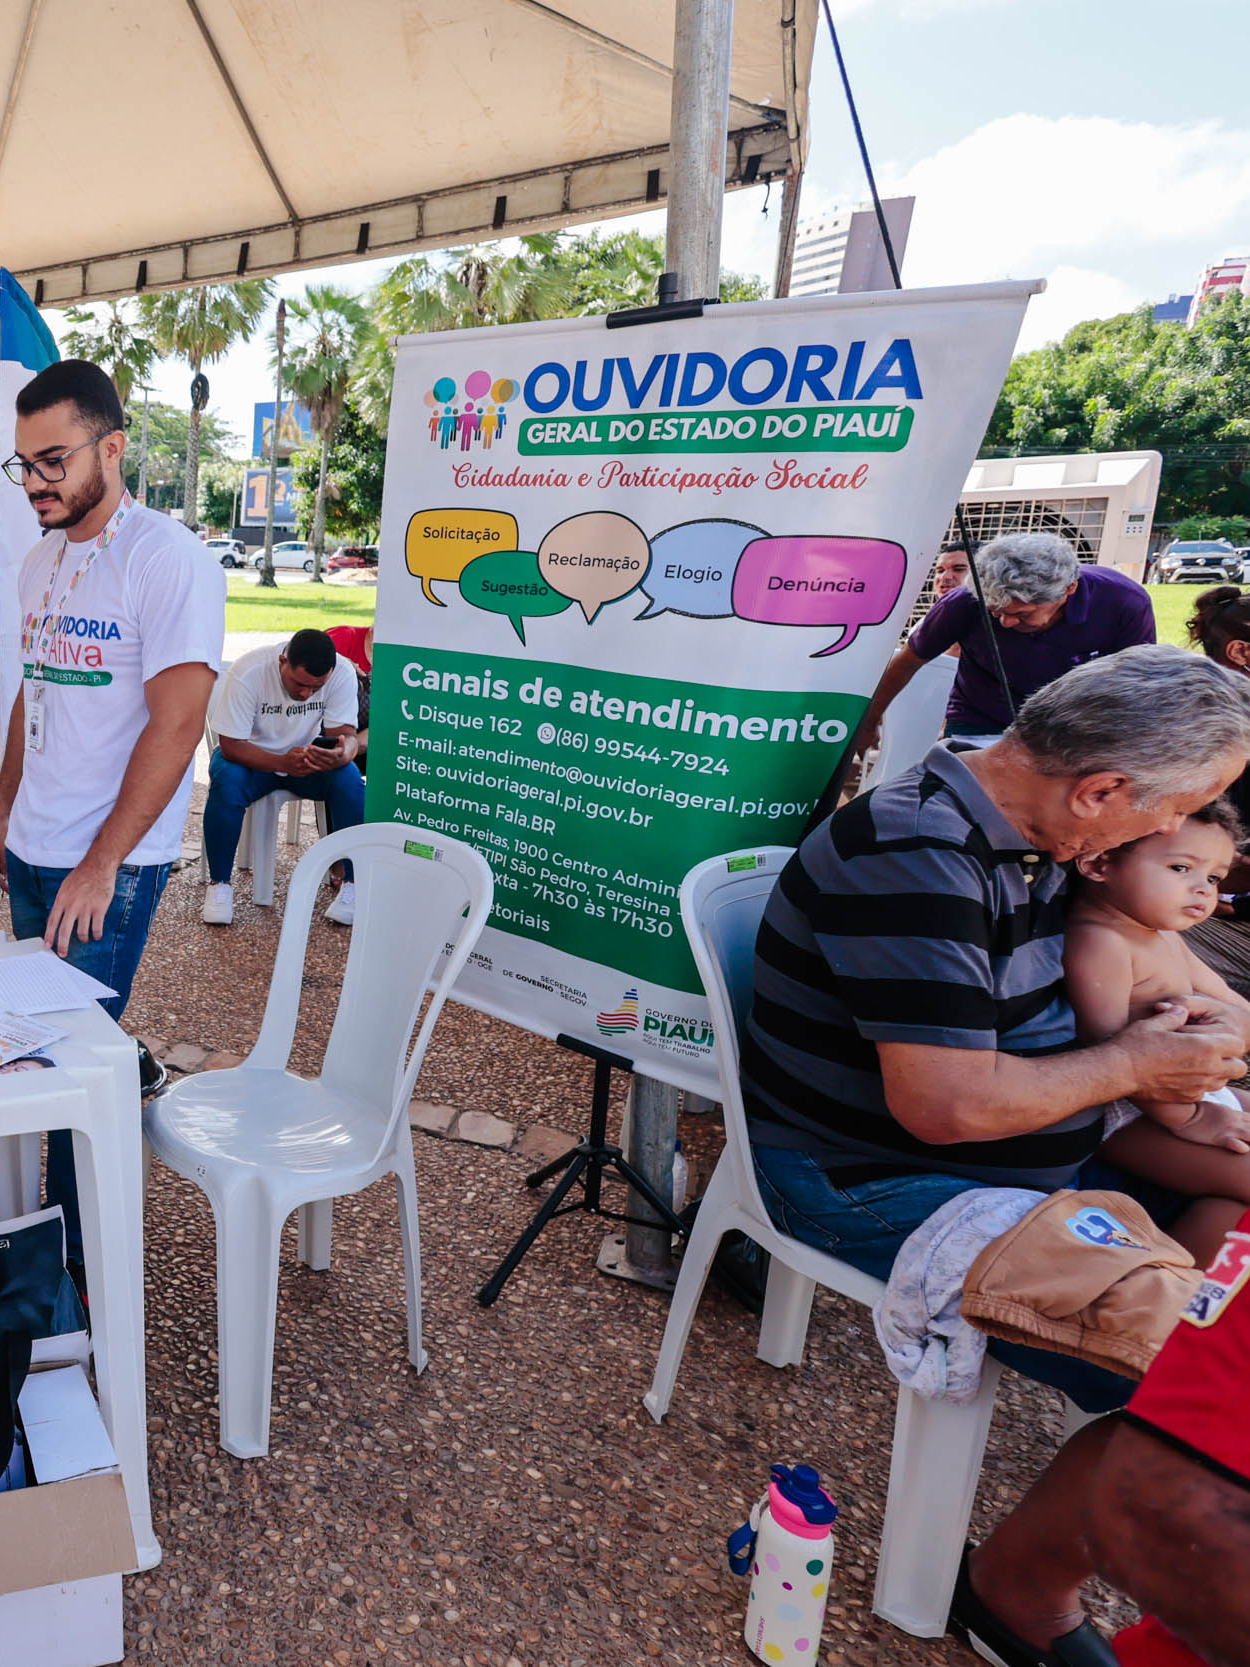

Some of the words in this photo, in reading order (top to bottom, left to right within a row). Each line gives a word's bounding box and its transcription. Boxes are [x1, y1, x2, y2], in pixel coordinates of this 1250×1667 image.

[523, 338, 923, 413] OUVIDORIA
[526, 418, 602, 444] GERAL
[609, 419, 646, 442] DO
[647, 415, 757, 441] ESTADO
[761, 414, 807, 439] DO
[812, 405, 908, 437] PIAUÍ
[452, 463, 573, 489] Cidadania
[577, 471, 592, 486] e
[597, 460, 758, 495] Participação
[764, 458, 869, 491] Social
[422, 526, 501, 542] Solicitação
[548, 552, 640, 573] Reclamação
[664, 563, 723, 583] Elogio
[480, 578, 549, 597] Sugestão
[767, 574, 866, 594] Denúncia
[40, 614, 122, 641] VIDORIA
[401, 662, 510, 700] Canais
[518, 677, 563, 708] de
[569, 690, 848, 743] atendimento
[418, 704, 484, 729] Disque
[489, 715, 523, 736] 162
[556, 727, 589, 752] (86)
[594, 737, 730, 776] 99544-7924
[395, 755, 432, 775] Site:
[435, 766, 653, 828] ouvidoriageral.pi.gov.br
[398, 731, 457, 755] E-mail:
[458, 744, 819, 820] atendimento@ouvidoriageral.pi.gov.
[395, 781, 490, 815] Plataforma
[495, 803, 556, 836] Fala.BR
[393, 808, 415, 823] Av.
[417, 813, 460, 833] Pedro
[463, 824, 510, 850] Freitas,
[513, 838, 549, 861] 1900
[552, 852, 608, 879] Centro
[510, 858, 536, 877] São
[540, 866, 591, 895] Pedro,
[595, 883, 671, 917] Teresina
[532, 882, 579, 910] 7h30
[584, 899, 606, 918] às
[611, 906, 674, 938] 17h30
[502, 969, 514, 978] DE
[515, 973, 554, 993] GOVERNO
[559, 991, 587, 1007] SEGOV
[540, 975, 588, 1000] SECRETARIA
[645, 1008, 698, 1025] GOVERNO
